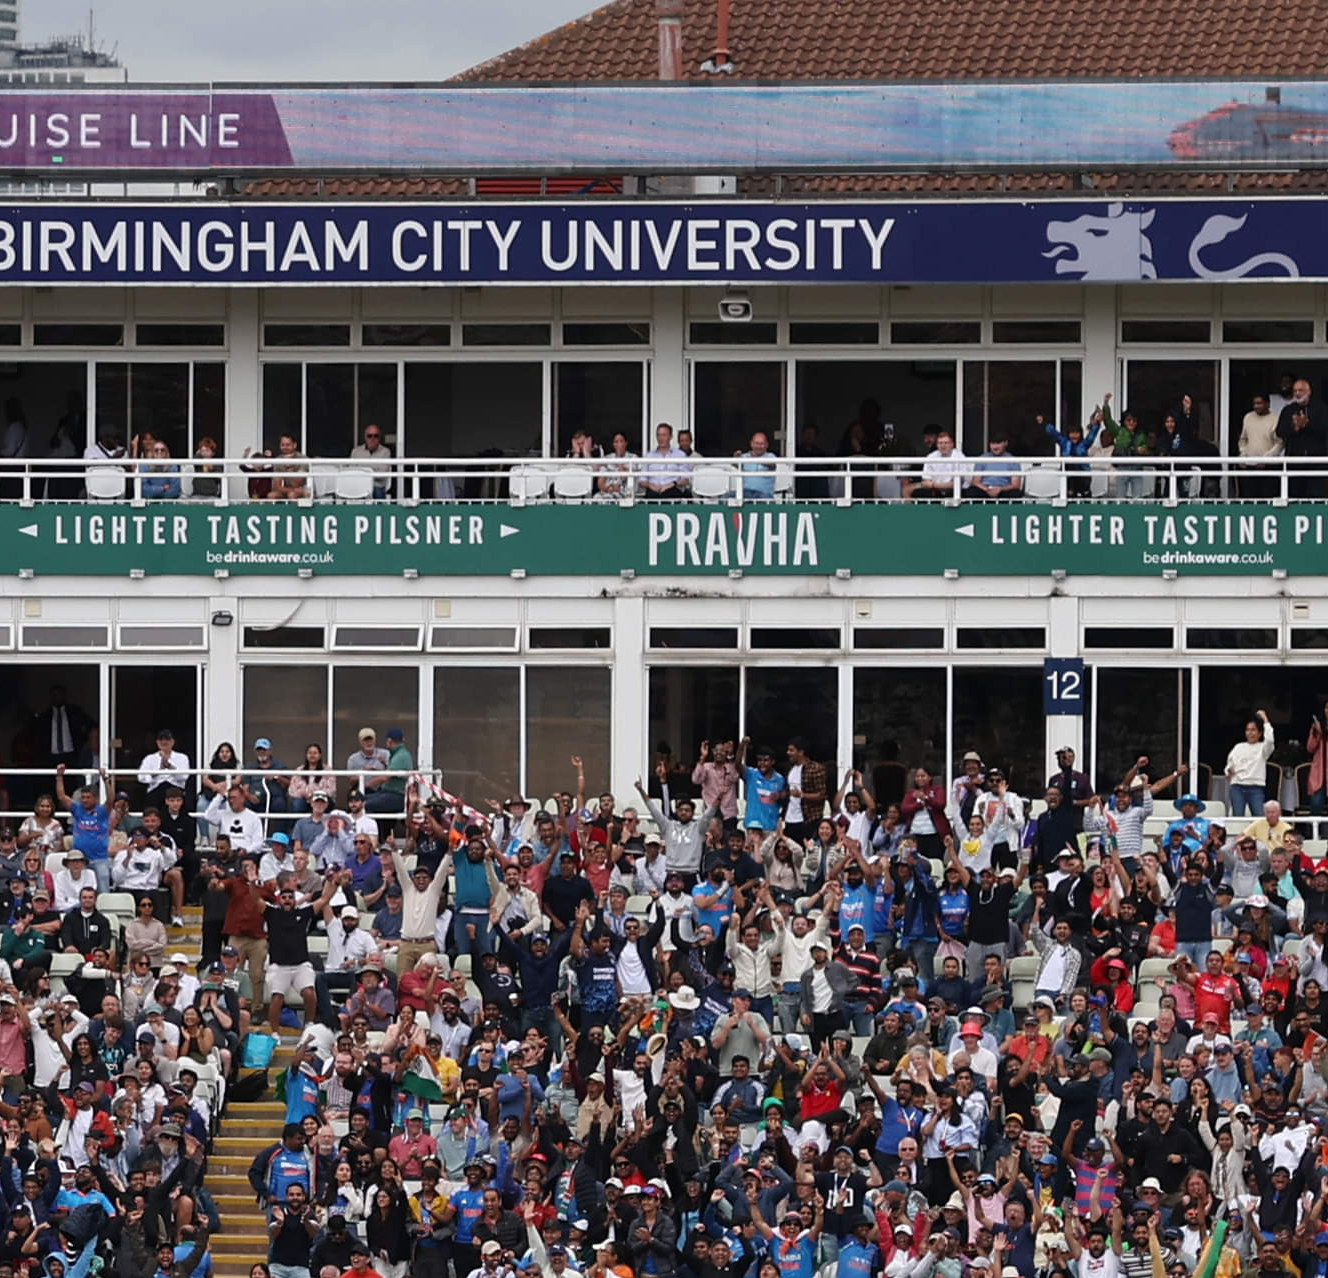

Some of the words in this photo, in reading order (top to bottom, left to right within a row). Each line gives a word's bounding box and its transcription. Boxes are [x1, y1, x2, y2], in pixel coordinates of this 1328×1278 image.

[130, 112, 240, 149] LINE
[392, 220, 522, 272] CITY
[541, 218, 895, 271] UNIVERSITY
[55, 515, 188, 545] LIGHTER
[207, 515, 338, 545] TASTING
[355, 515, 486, 546] PILSNER
[648, 512, 820, 566] PRAVHA
[992, 514, 1124, 545] LIGHTER
[1144, 515, 1277, 545] TASTING
[206, 550, 334, 563] bedrinkaware.co.uk
[1143, 550, 1274, 564] bedrinkaware.co.uk
[1046, 671, 1080, 700] 12
